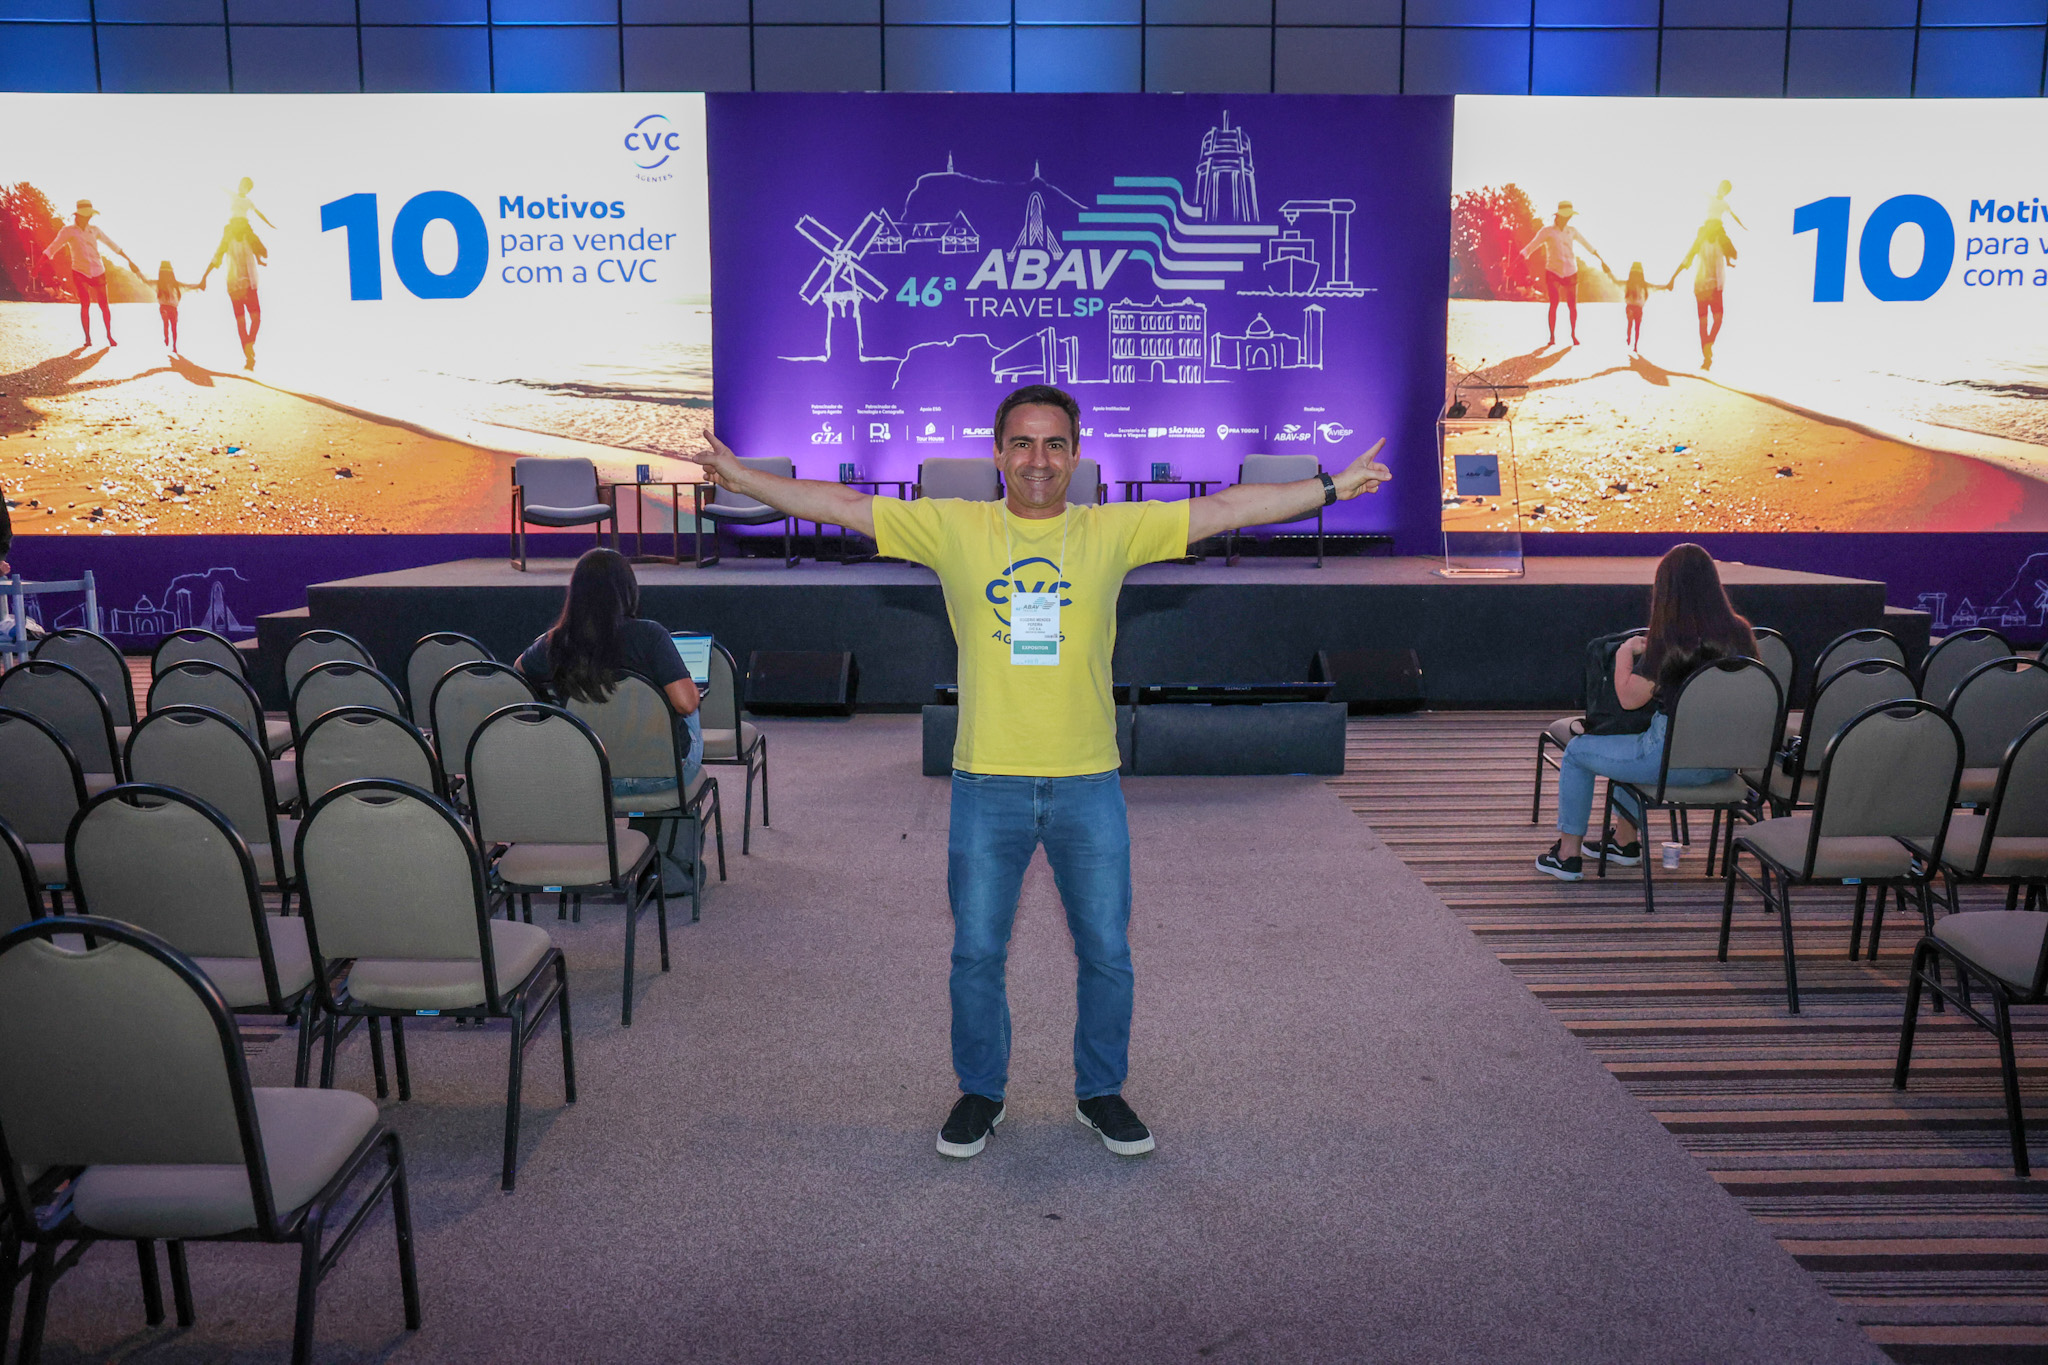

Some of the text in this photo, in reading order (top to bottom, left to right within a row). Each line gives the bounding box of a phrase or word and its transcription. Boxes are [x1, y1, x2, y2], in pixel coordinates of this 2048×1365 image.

[624, 132, 680, 151] CVC
[635, 173, 673, 183] AGENTES
[499, 194, 625, 219] Motivos
[320, 190, 489, 300] 10
[501, 227, 677, 258] para vender
[1793, 194, 1955, 302] 10
[1966, 237, 2029, 261] para
[502, 259, 657, 283] com a CVC
[966, 249, 1128, 290] ABAV
[1964, 268, 2048, 286] com a
[811, 432, 842, 442] GTA
[1274, 432, 1311, 441] ABAV-SP
